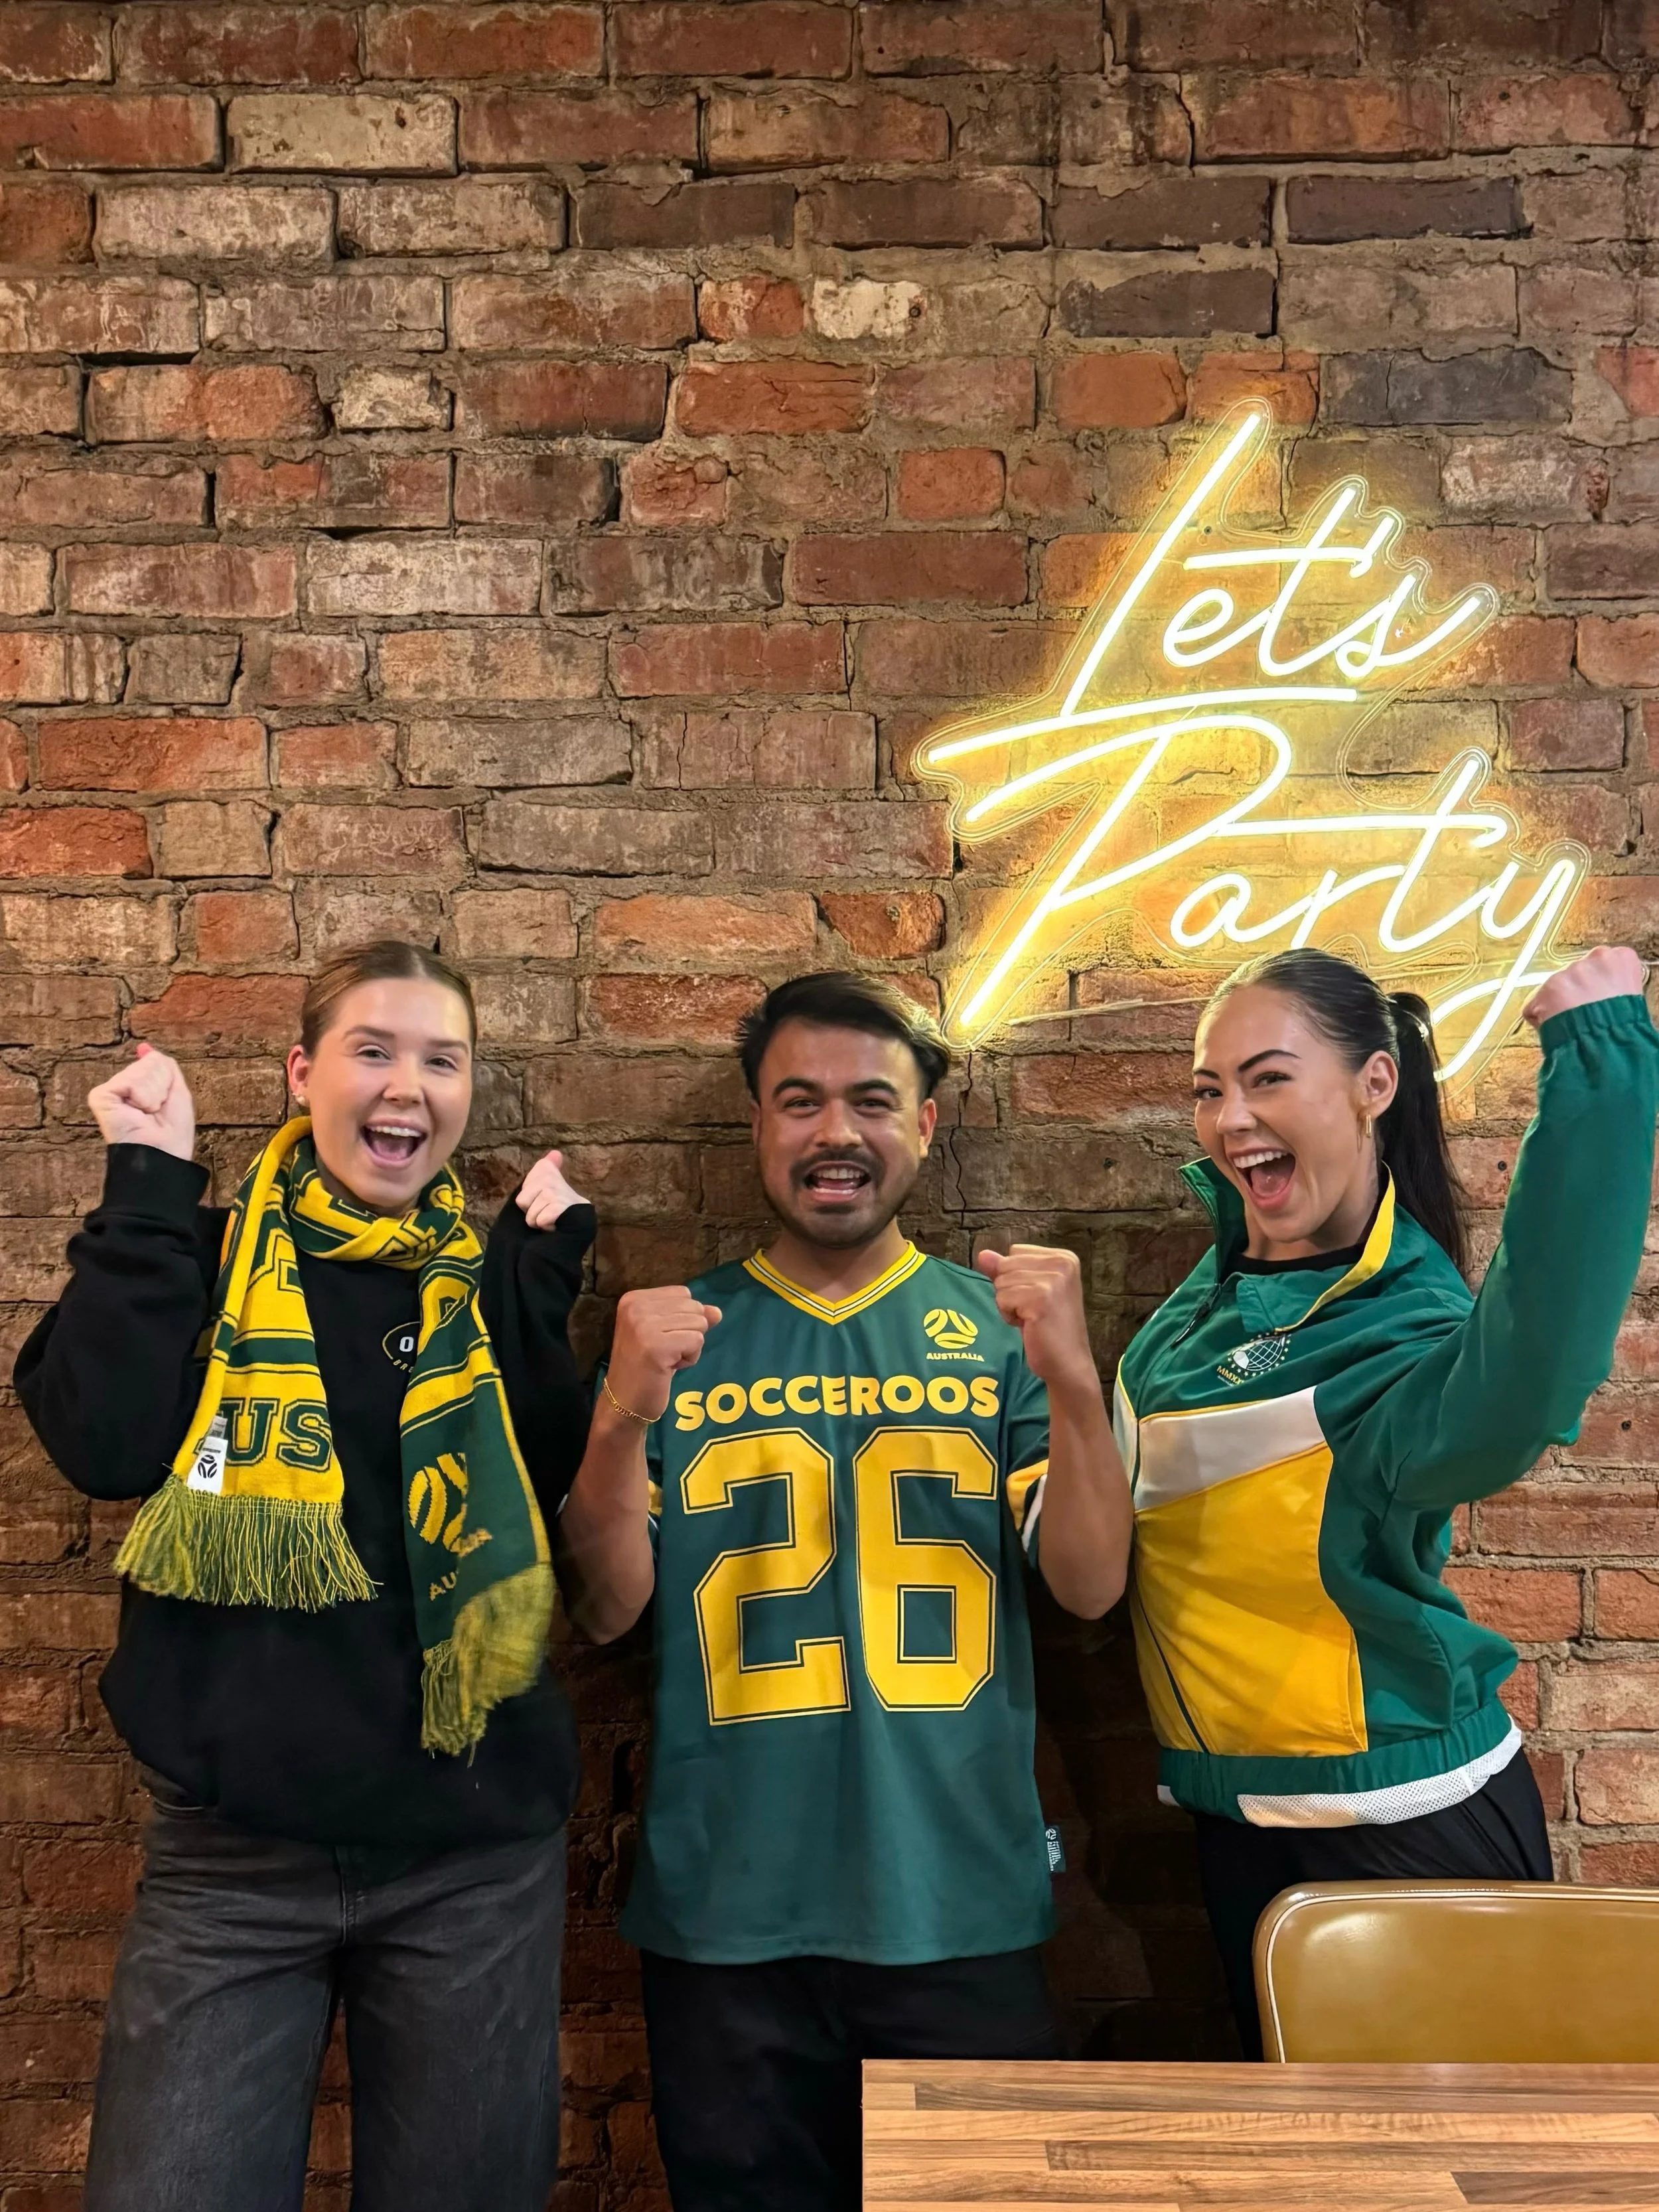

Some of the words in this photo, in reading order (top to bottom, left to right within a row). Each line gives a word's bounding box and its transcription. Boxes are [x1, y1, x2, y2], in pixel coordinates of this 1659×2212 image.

[960, 714, 1575, 1082] Party
[926, 1353, 984, 1362] AUSTRALIA
[1216, 1365, 1245, 1385] MMXX
[674, 1374, 999, 1431] SOCCEROOS
[194, 1398, 332, 1473] US
[429, 1571, 459, 1601] AU
[680, 1426, 997, 1726] 26
